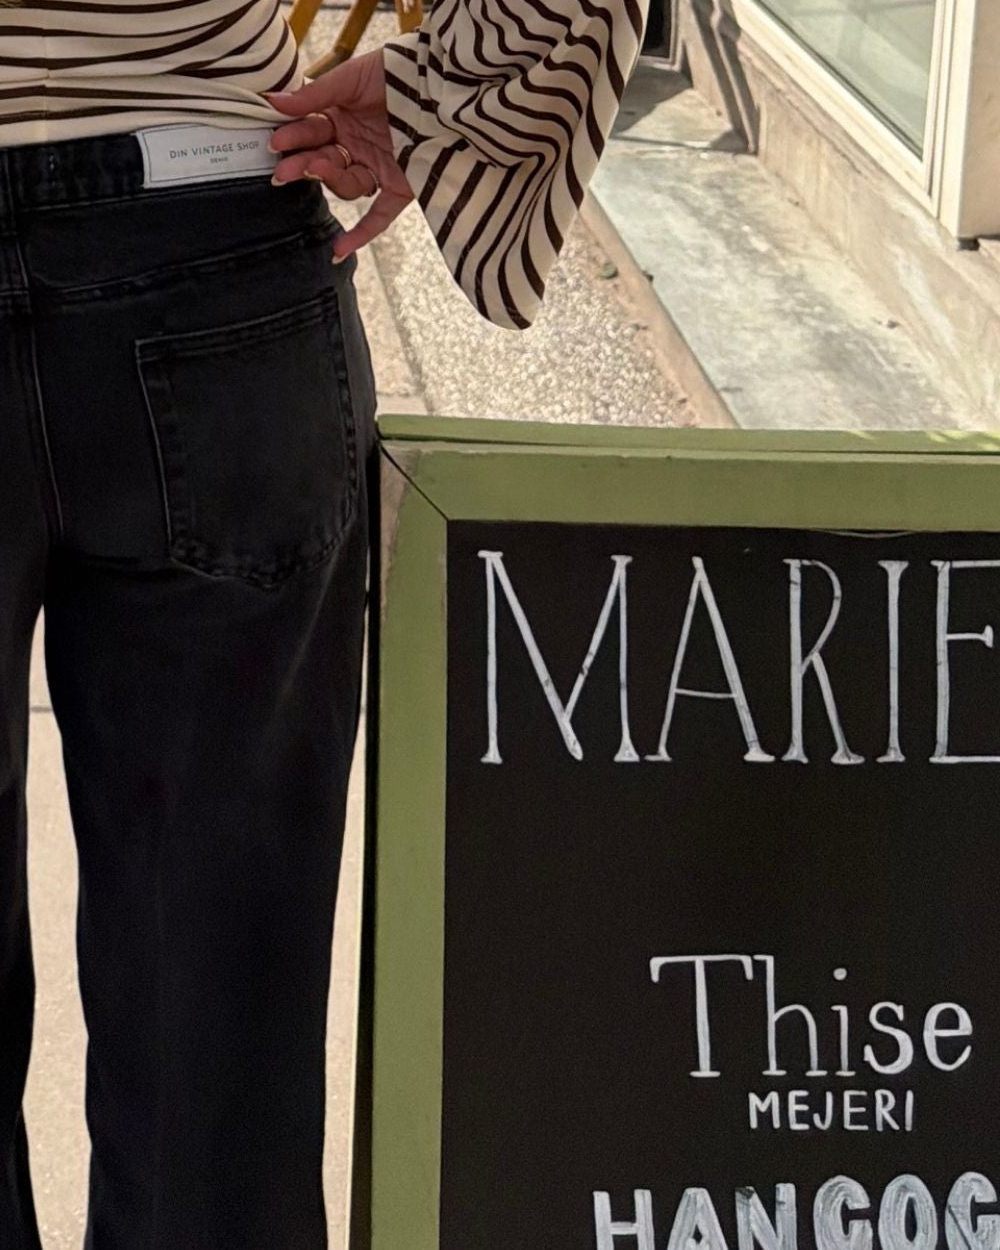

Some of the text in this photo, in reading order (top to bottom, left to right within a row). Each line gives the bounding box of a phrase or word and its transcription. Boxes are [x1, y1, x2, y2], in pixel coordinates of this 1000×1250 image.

[169, 141, 260, 159] DIN VINTAGE SHOP
[478, 550, 1000, 764] MARIE
[650, 955, 972, 1077] Thise
[749, 1089, 913, 1131] MEJERI
